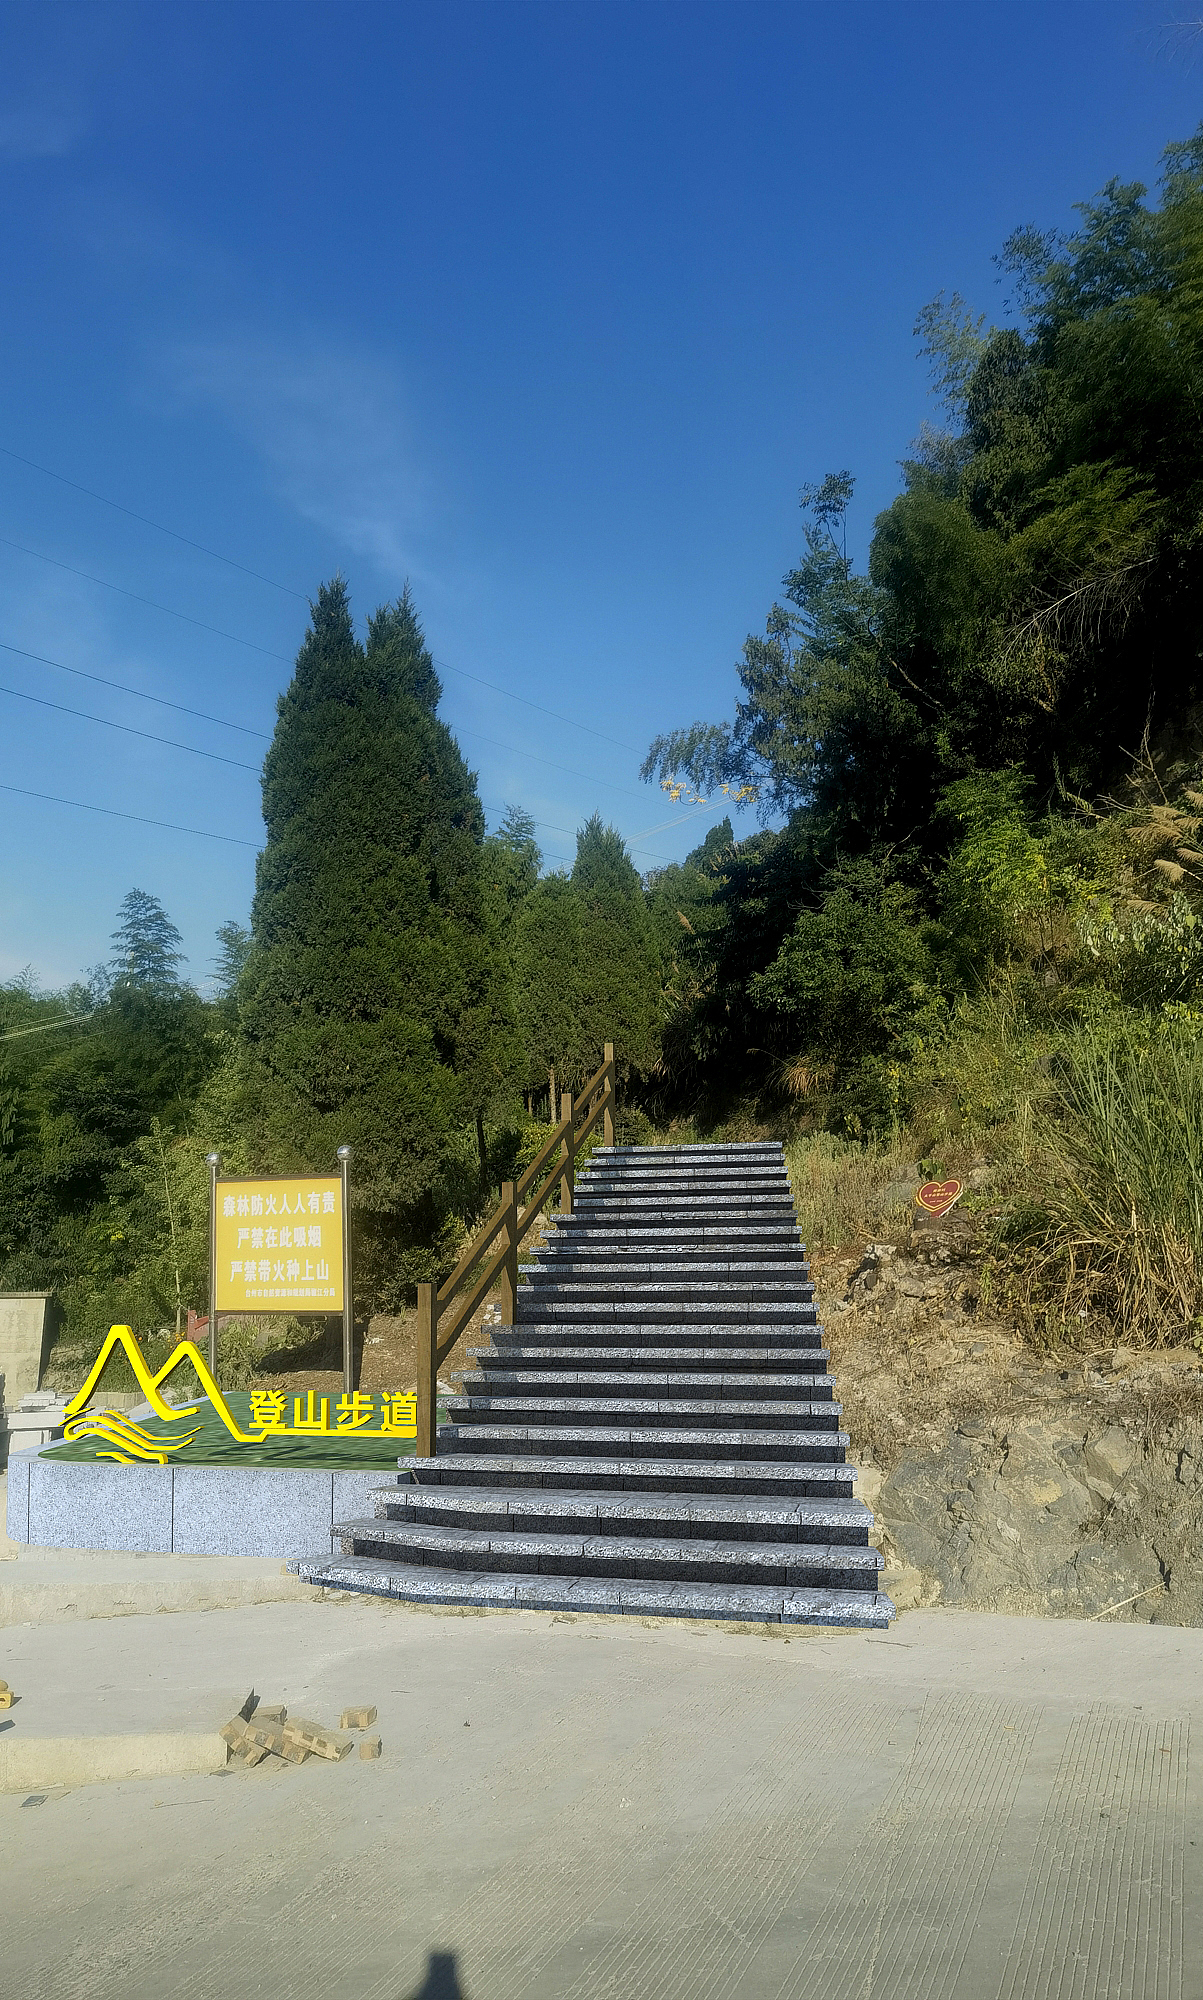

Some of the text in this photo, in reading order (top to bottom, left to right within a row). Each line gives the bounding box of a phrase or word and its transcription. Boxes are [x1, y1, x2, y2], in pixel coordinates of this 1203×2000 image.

[223, 1190, 336, 1217] 森林防火人人有责
[237, 1225, 322, 1249] 严禁在此吸烟
[230, 1258, 329, 1282] 严禁带火种上山
[249, 1389, 418, 1431] 登山步道
